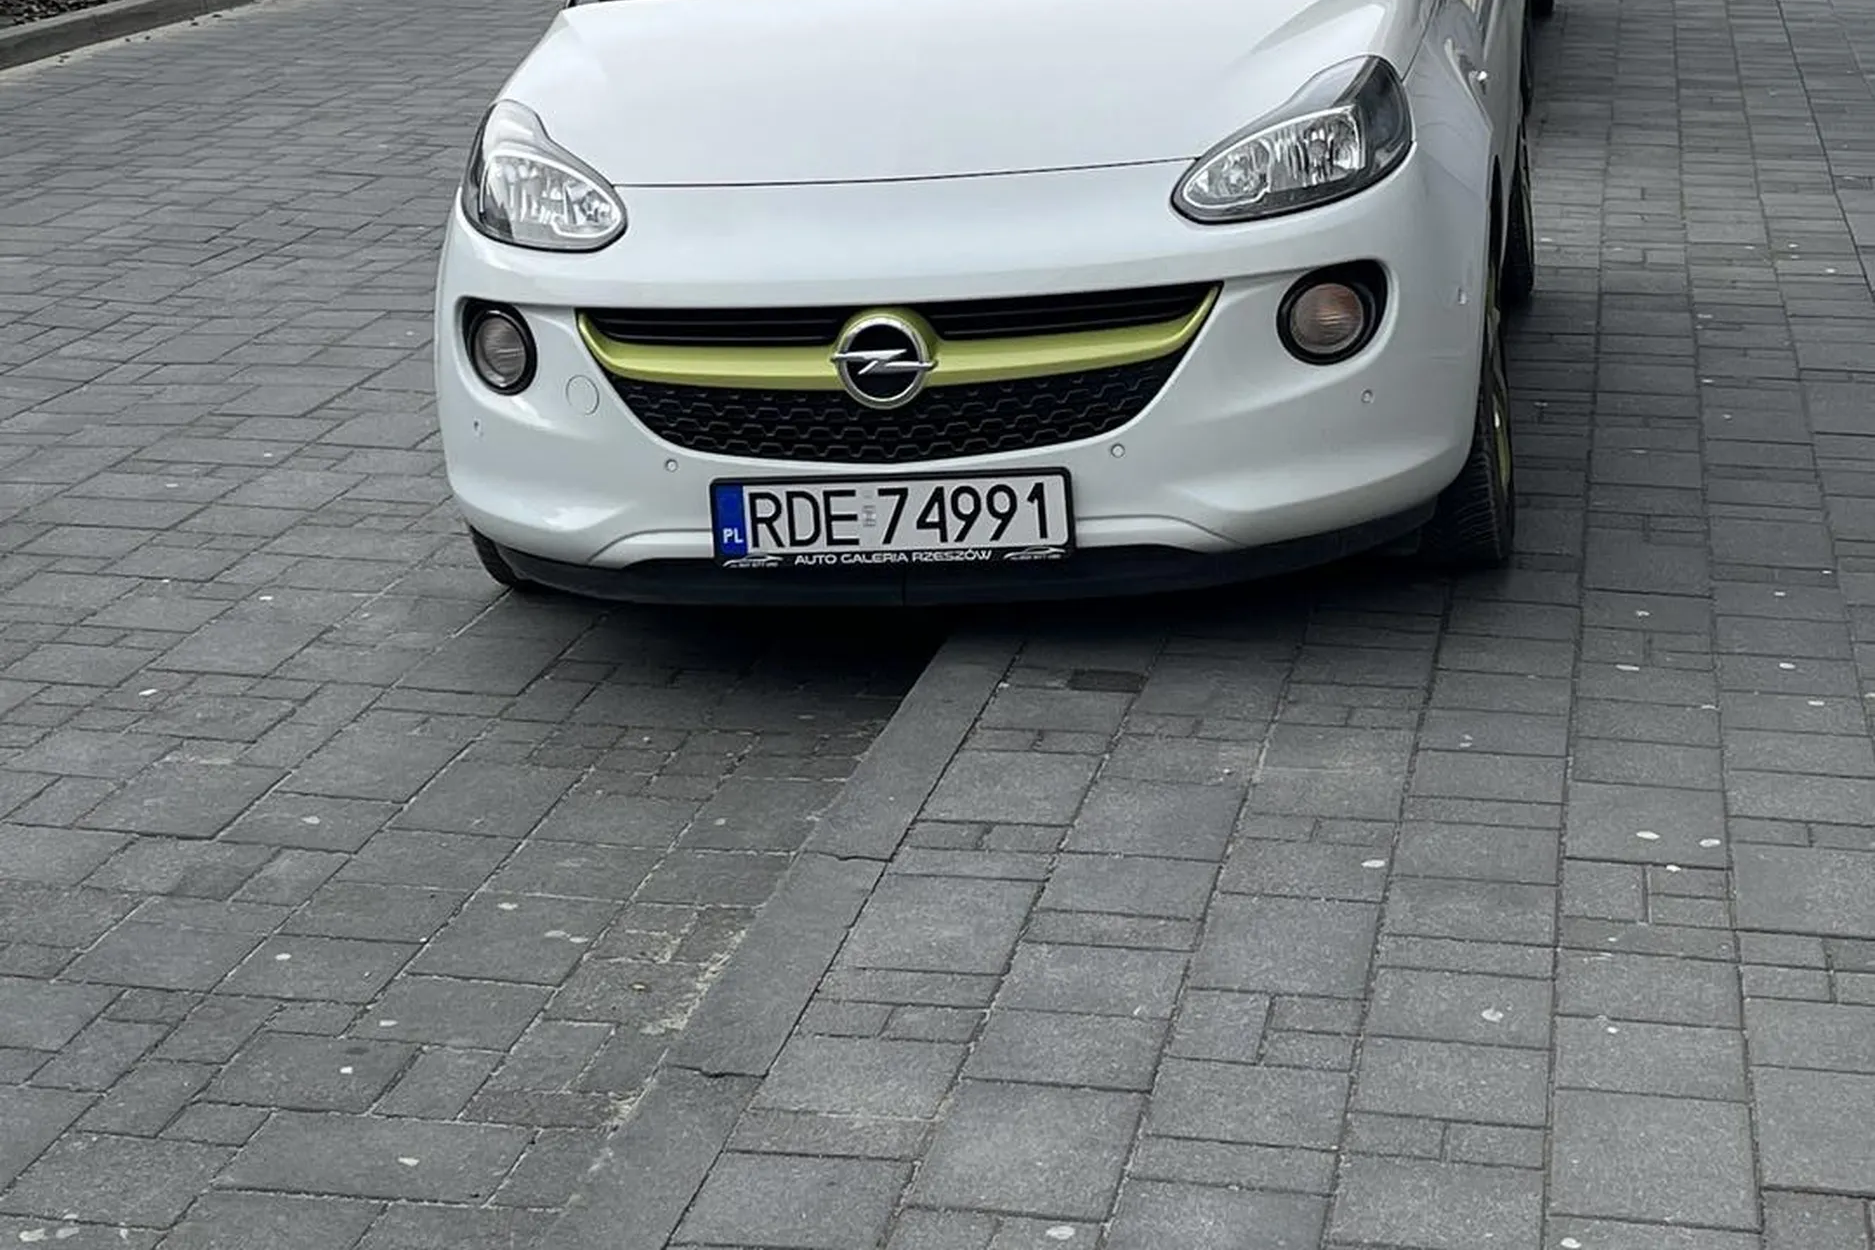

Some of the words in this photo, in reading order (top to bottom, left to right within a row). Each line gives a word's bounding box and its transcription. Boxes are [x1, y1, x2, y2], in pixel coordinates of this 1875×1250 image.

[748, 489, 860, 549] RDE
[877, 481, 1049, 546] 74991
[723, 527, 744, 544] PL
[794, 553, 837, 566] AUTO
[840, 551, 909, 565] GALERIA
[912, 548, 993, 563] RZESZÓW
